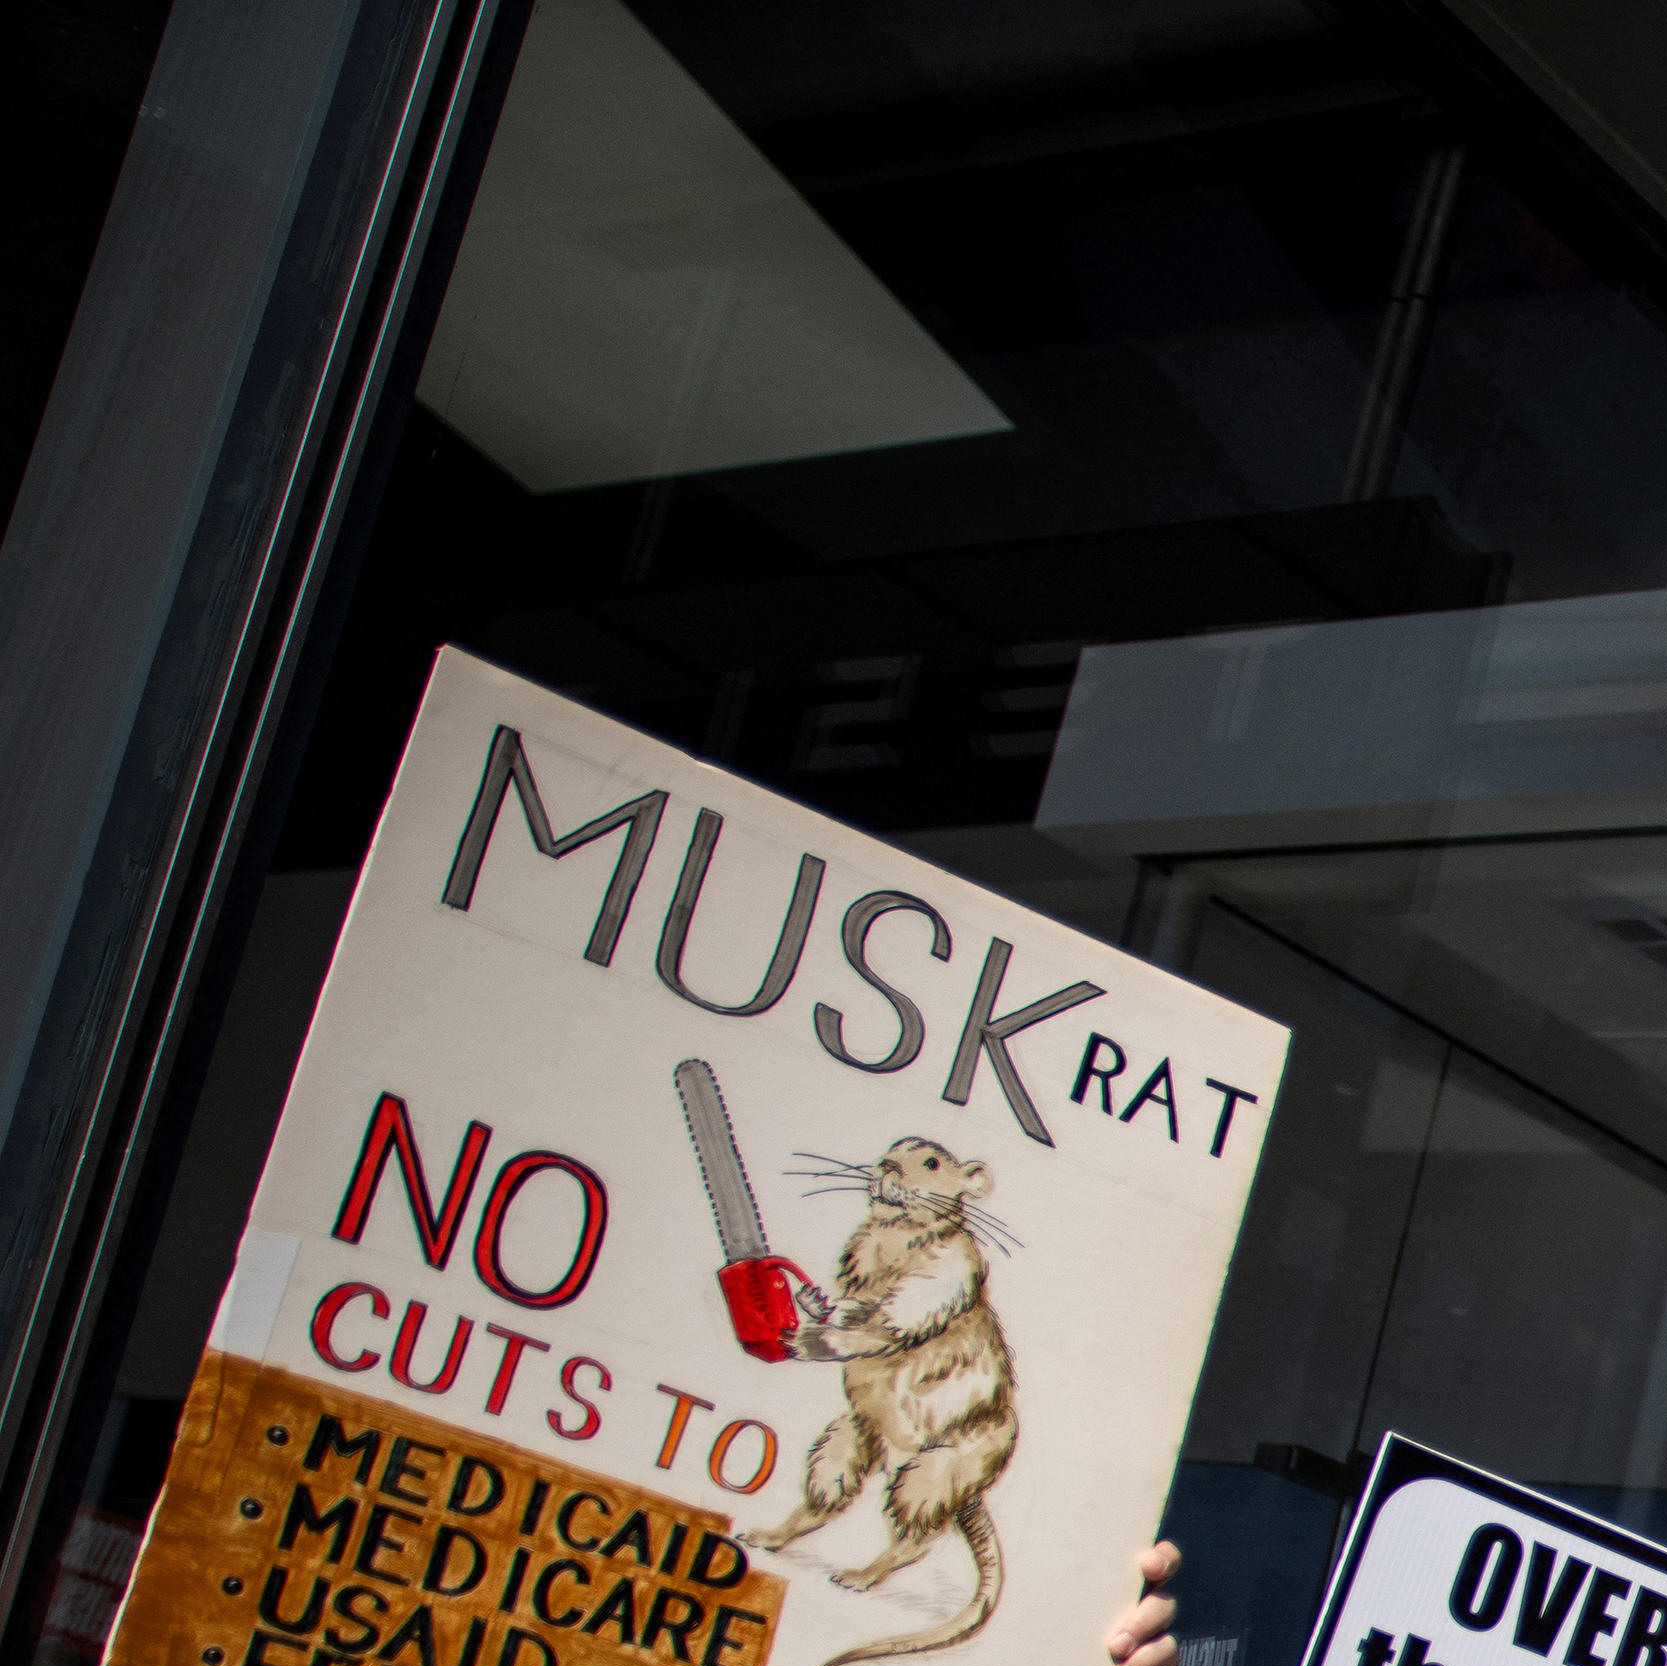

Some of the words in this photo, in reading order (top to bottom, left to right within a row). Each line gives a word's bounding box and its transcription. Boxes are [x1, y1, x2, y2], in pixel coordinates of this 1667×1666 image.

[331, 1092, 608, 1309] NO
[310, 1281, 614, 1442] CUTS
[653, 1383, 778, 1495] TO
[303, 1415, 748, 1590] MEDICAID
